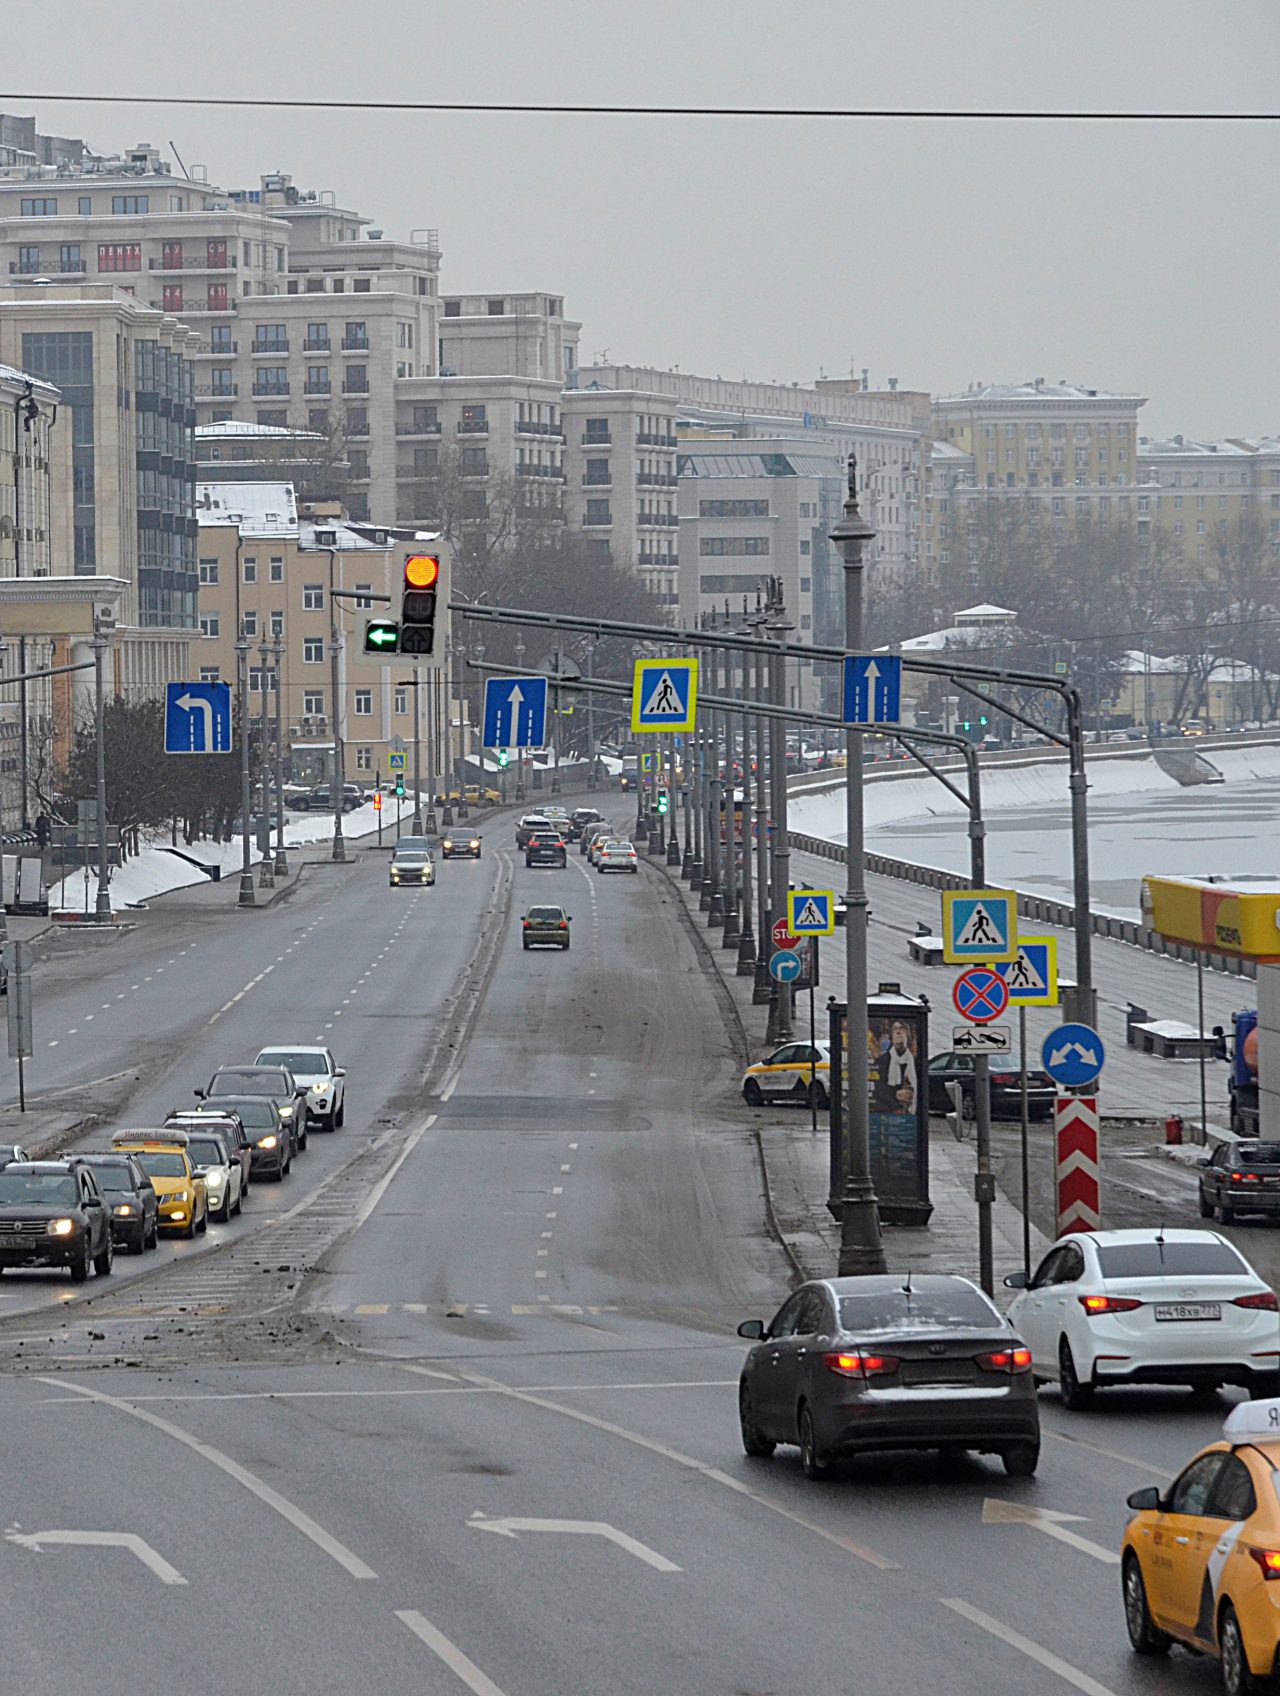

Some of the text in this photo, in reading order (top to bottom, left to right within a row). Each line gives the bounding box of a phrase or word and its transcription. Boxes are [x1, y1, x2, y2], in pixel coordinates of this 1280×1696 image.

[773, 928, 797, 940] STO
[124, 1130, 153, 1139] Яндекс
[1268, 1407, 1280, 1427] Я
